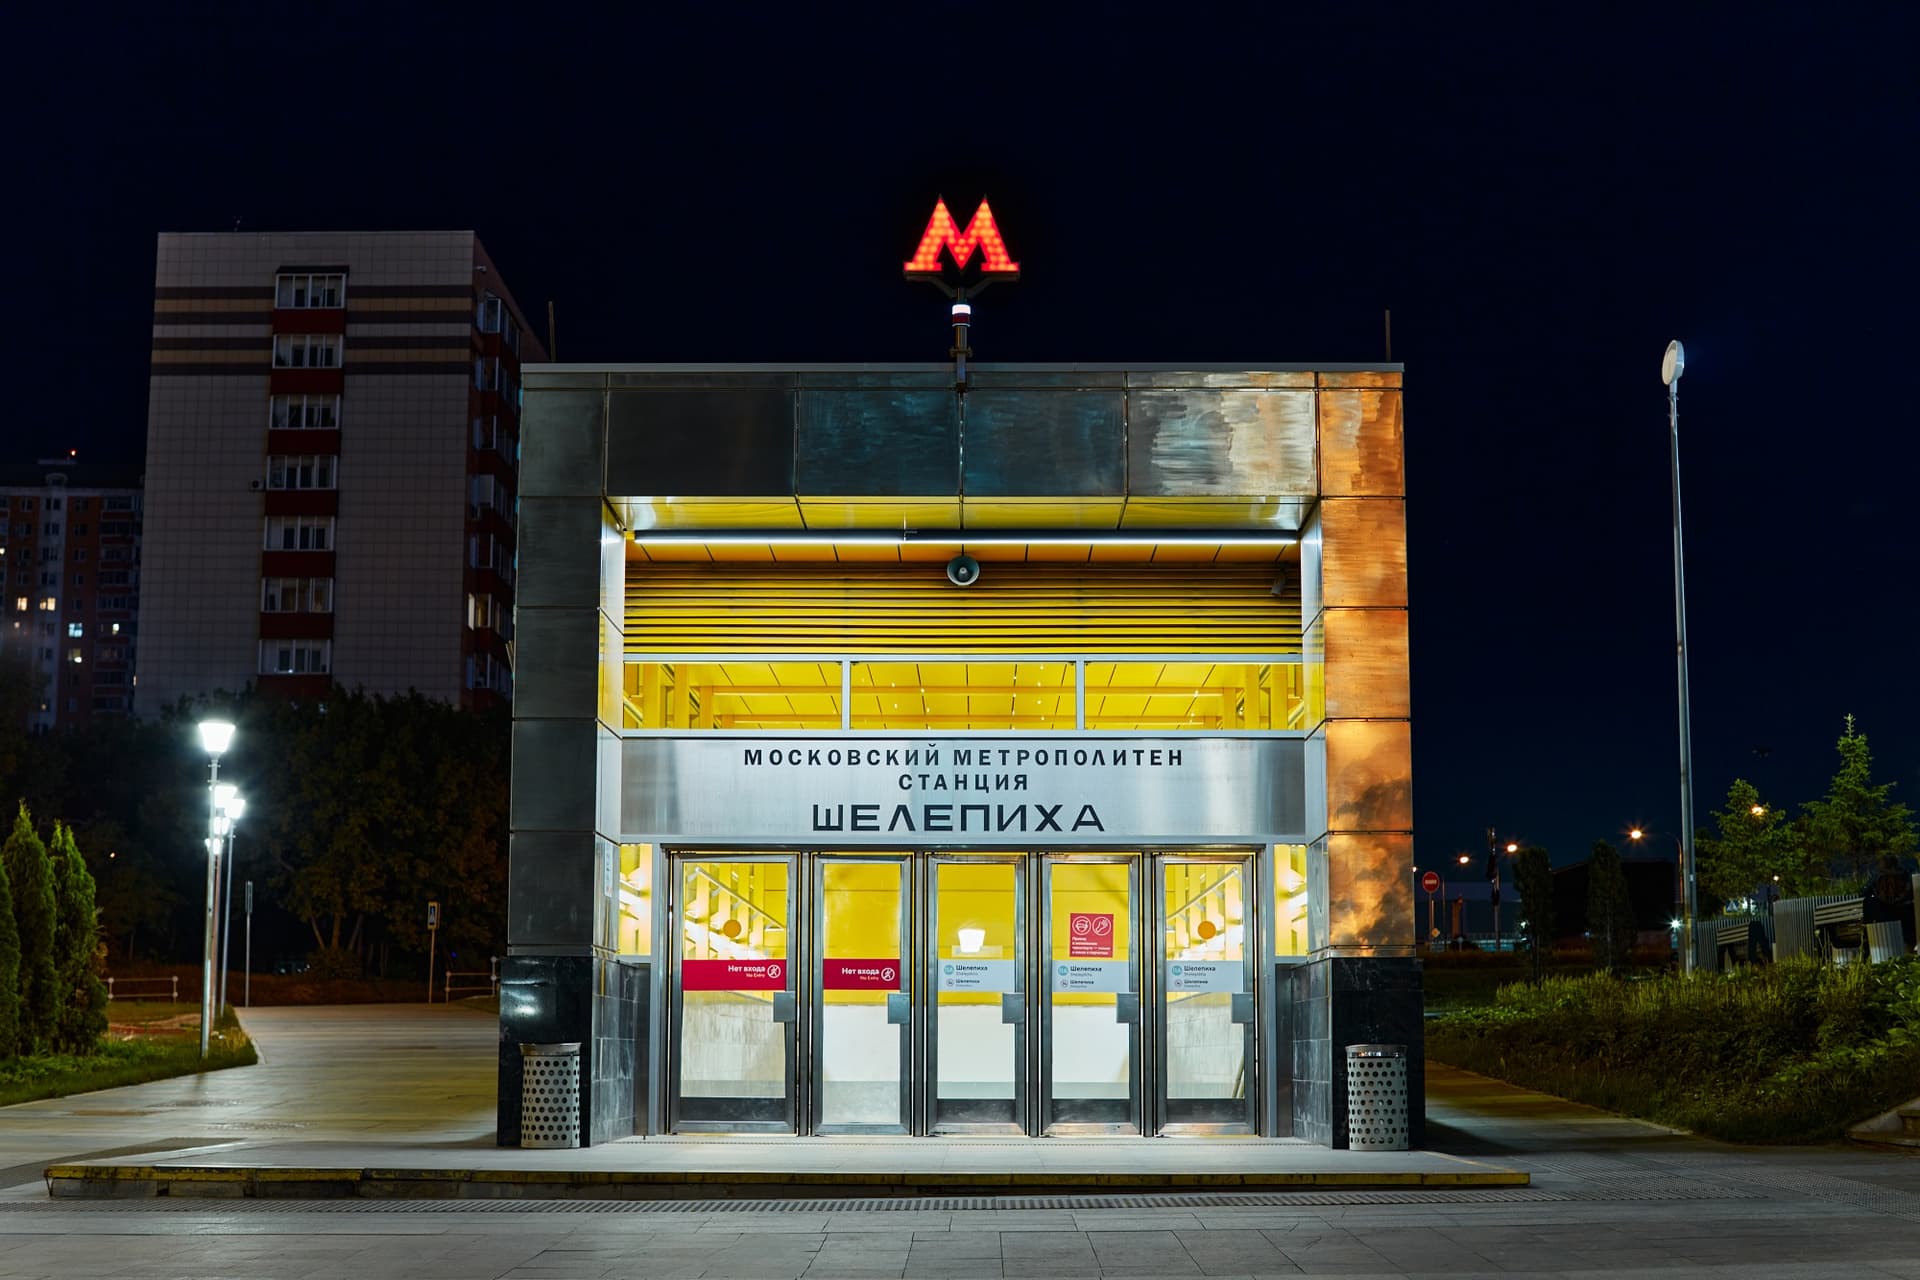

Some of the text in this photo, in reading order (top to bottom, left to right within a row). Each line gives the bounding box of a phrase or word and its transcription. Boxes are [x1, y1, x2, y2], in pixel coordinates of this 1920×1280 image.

[903, 196, 1020, 272] М
[744, 743, 1183, 766] МОСКОВСКИЙ МЕТРОПОЛИТЕН
[898, 774, 1029, 793] СТАНЦИЯ
[812, 804, 1105, 832] ШЕЛЕПИХА
[728, 964, 743, 973] Нет
[841, 967, 857, 975] Нет
